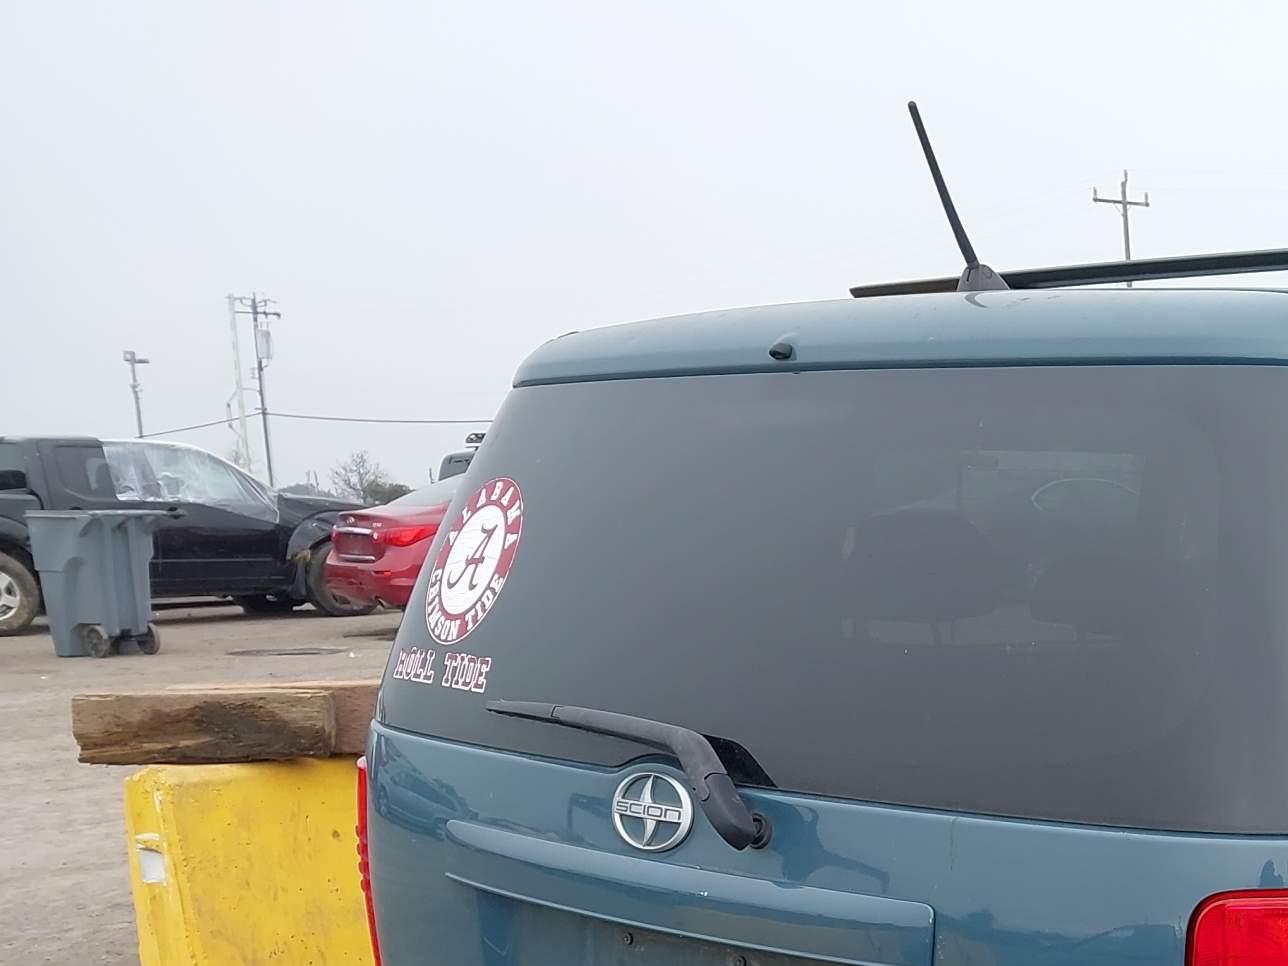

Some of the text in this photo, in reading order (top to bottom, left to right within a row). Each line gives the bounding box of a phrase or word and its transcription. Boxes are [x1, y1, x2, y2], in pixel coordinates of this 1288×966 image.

[448, 481, 522, 550] ALABAMA
[427, 568, 505, 641] CRIMSON TIDE
[393, 647, 492, 694] ROLL TIDE
